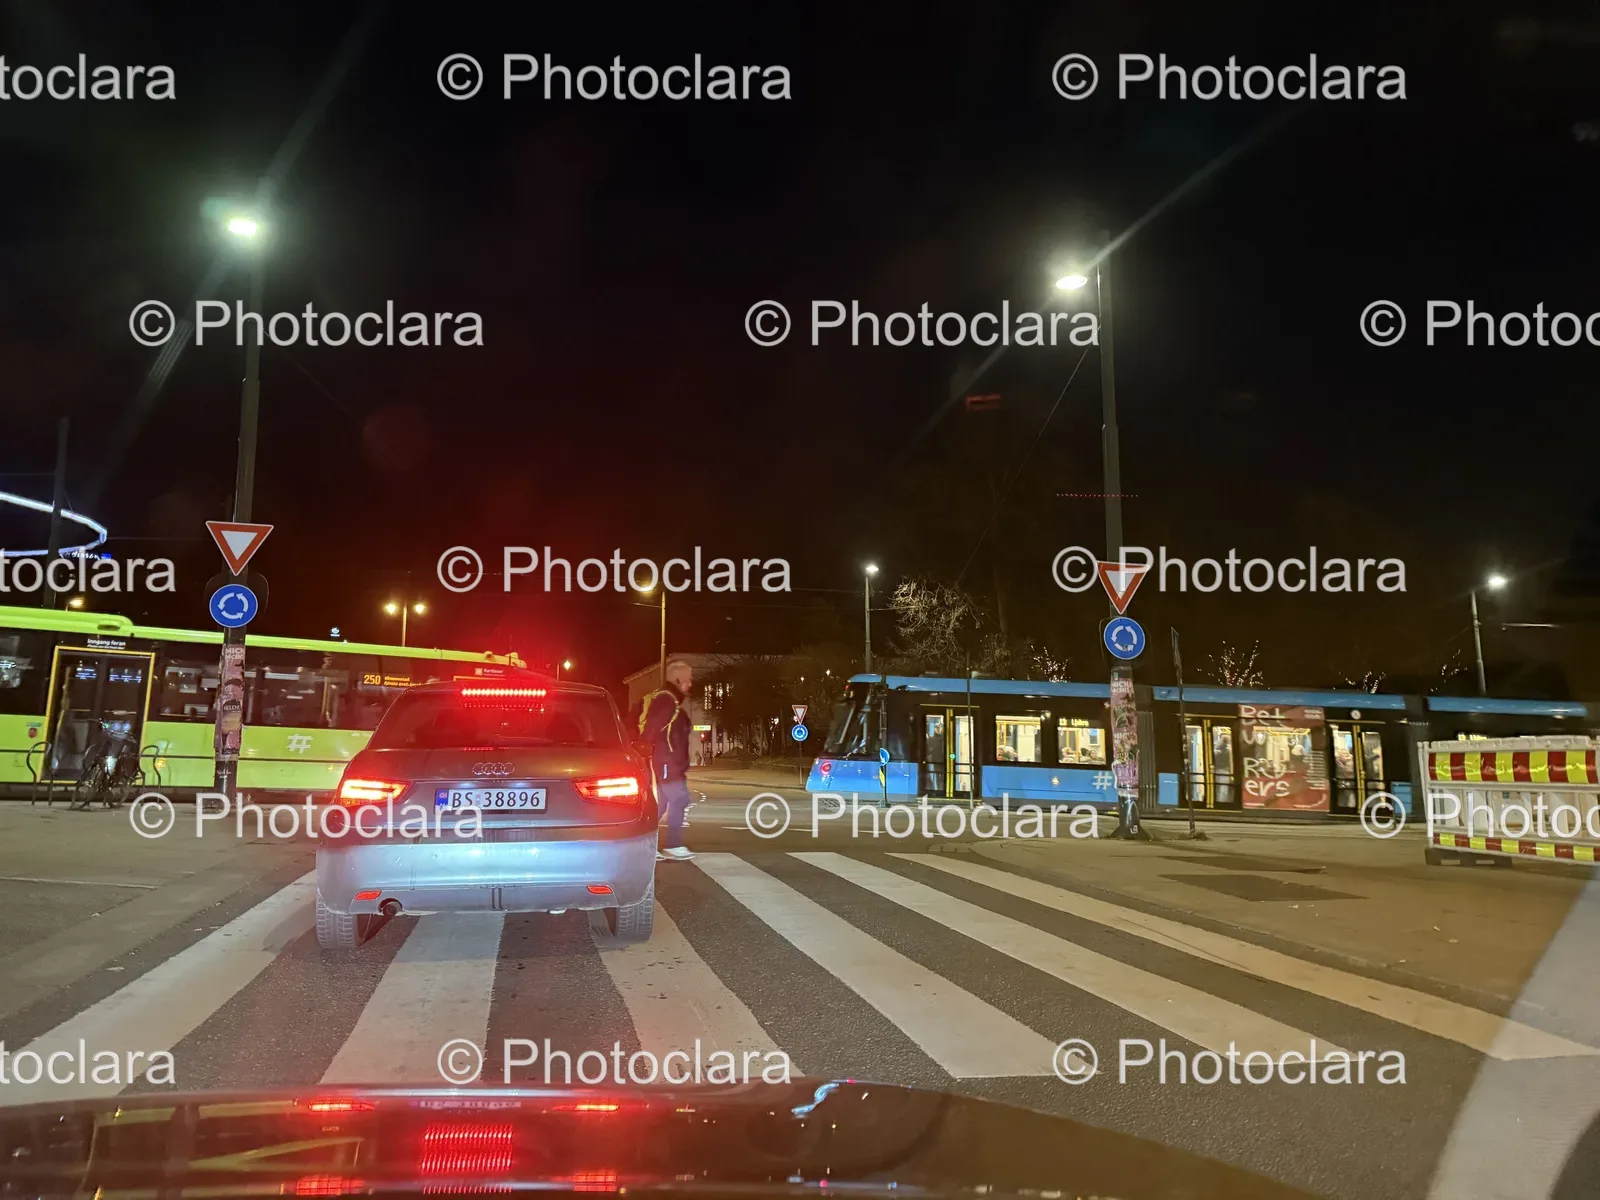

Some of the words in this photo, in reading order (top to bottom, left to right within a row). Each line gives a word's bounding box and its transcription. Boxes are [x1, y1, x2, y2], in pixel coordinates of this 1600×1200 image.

[363, 674, 381, 685] 250
[452, 791, 473, 808] BS
[482, 791, 540, 808] 38896
